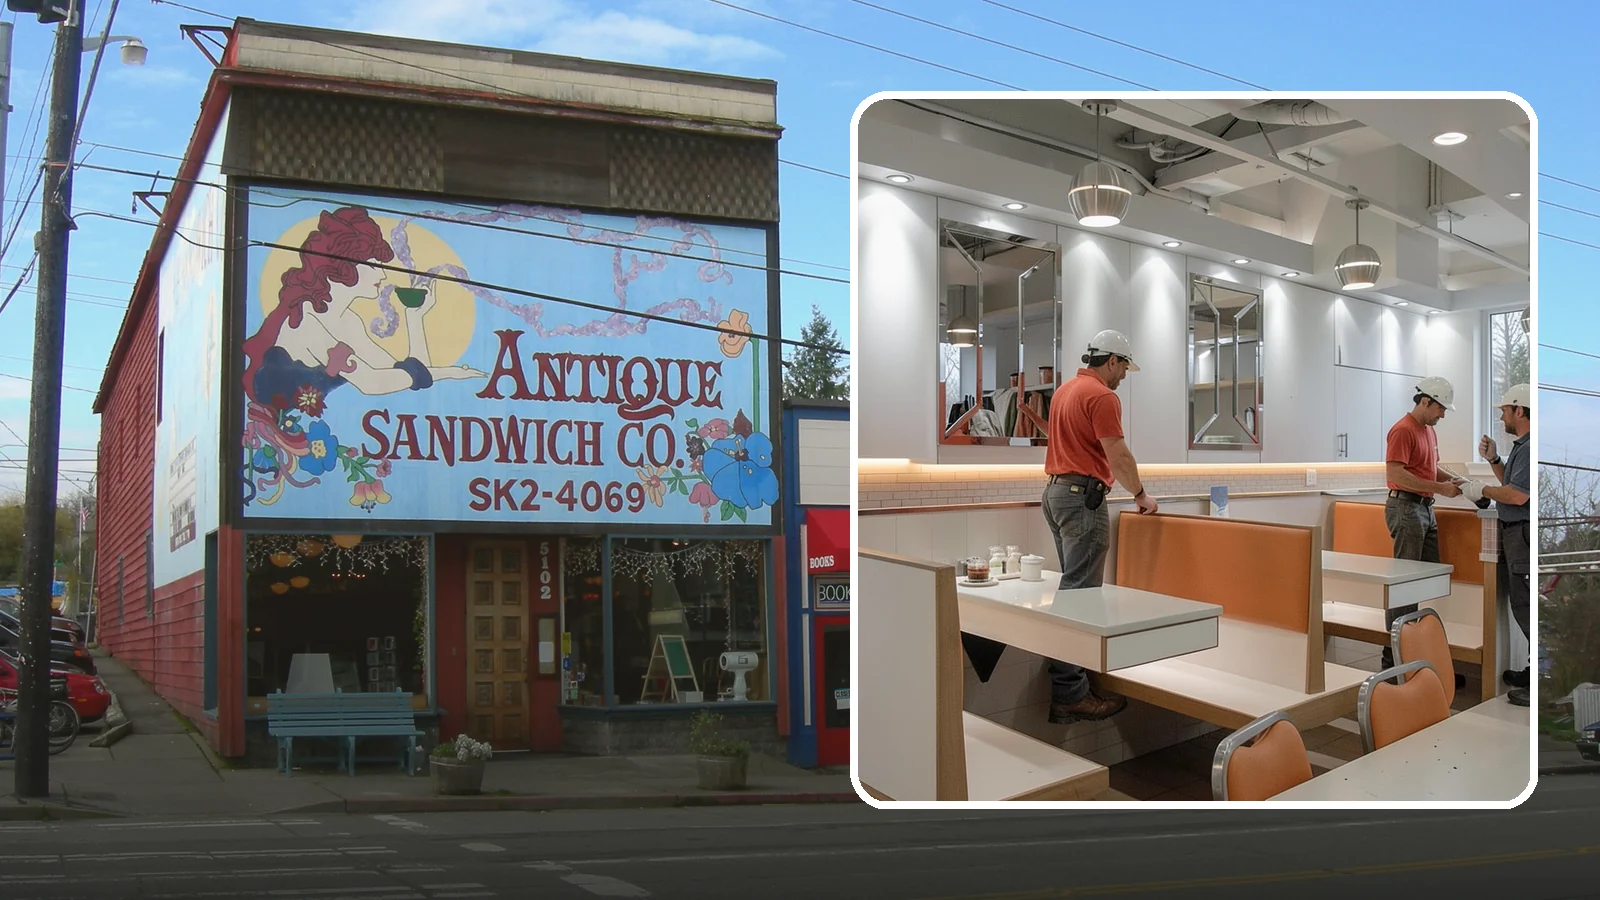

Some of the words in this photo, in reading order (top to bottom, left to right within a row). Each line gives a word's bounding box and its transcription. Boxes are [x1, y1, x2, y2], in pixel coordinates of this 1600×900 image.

[475, 329, 724, 420] ANTIQUE
[361, 408, 604, 467] SANDWICH
[616, 422, 685, 469] CO.
[468, 476, 645, 512] SK2-4069
[540, 541, 551, 599] 5102
[809, 555, 834, 569] BOOKS
